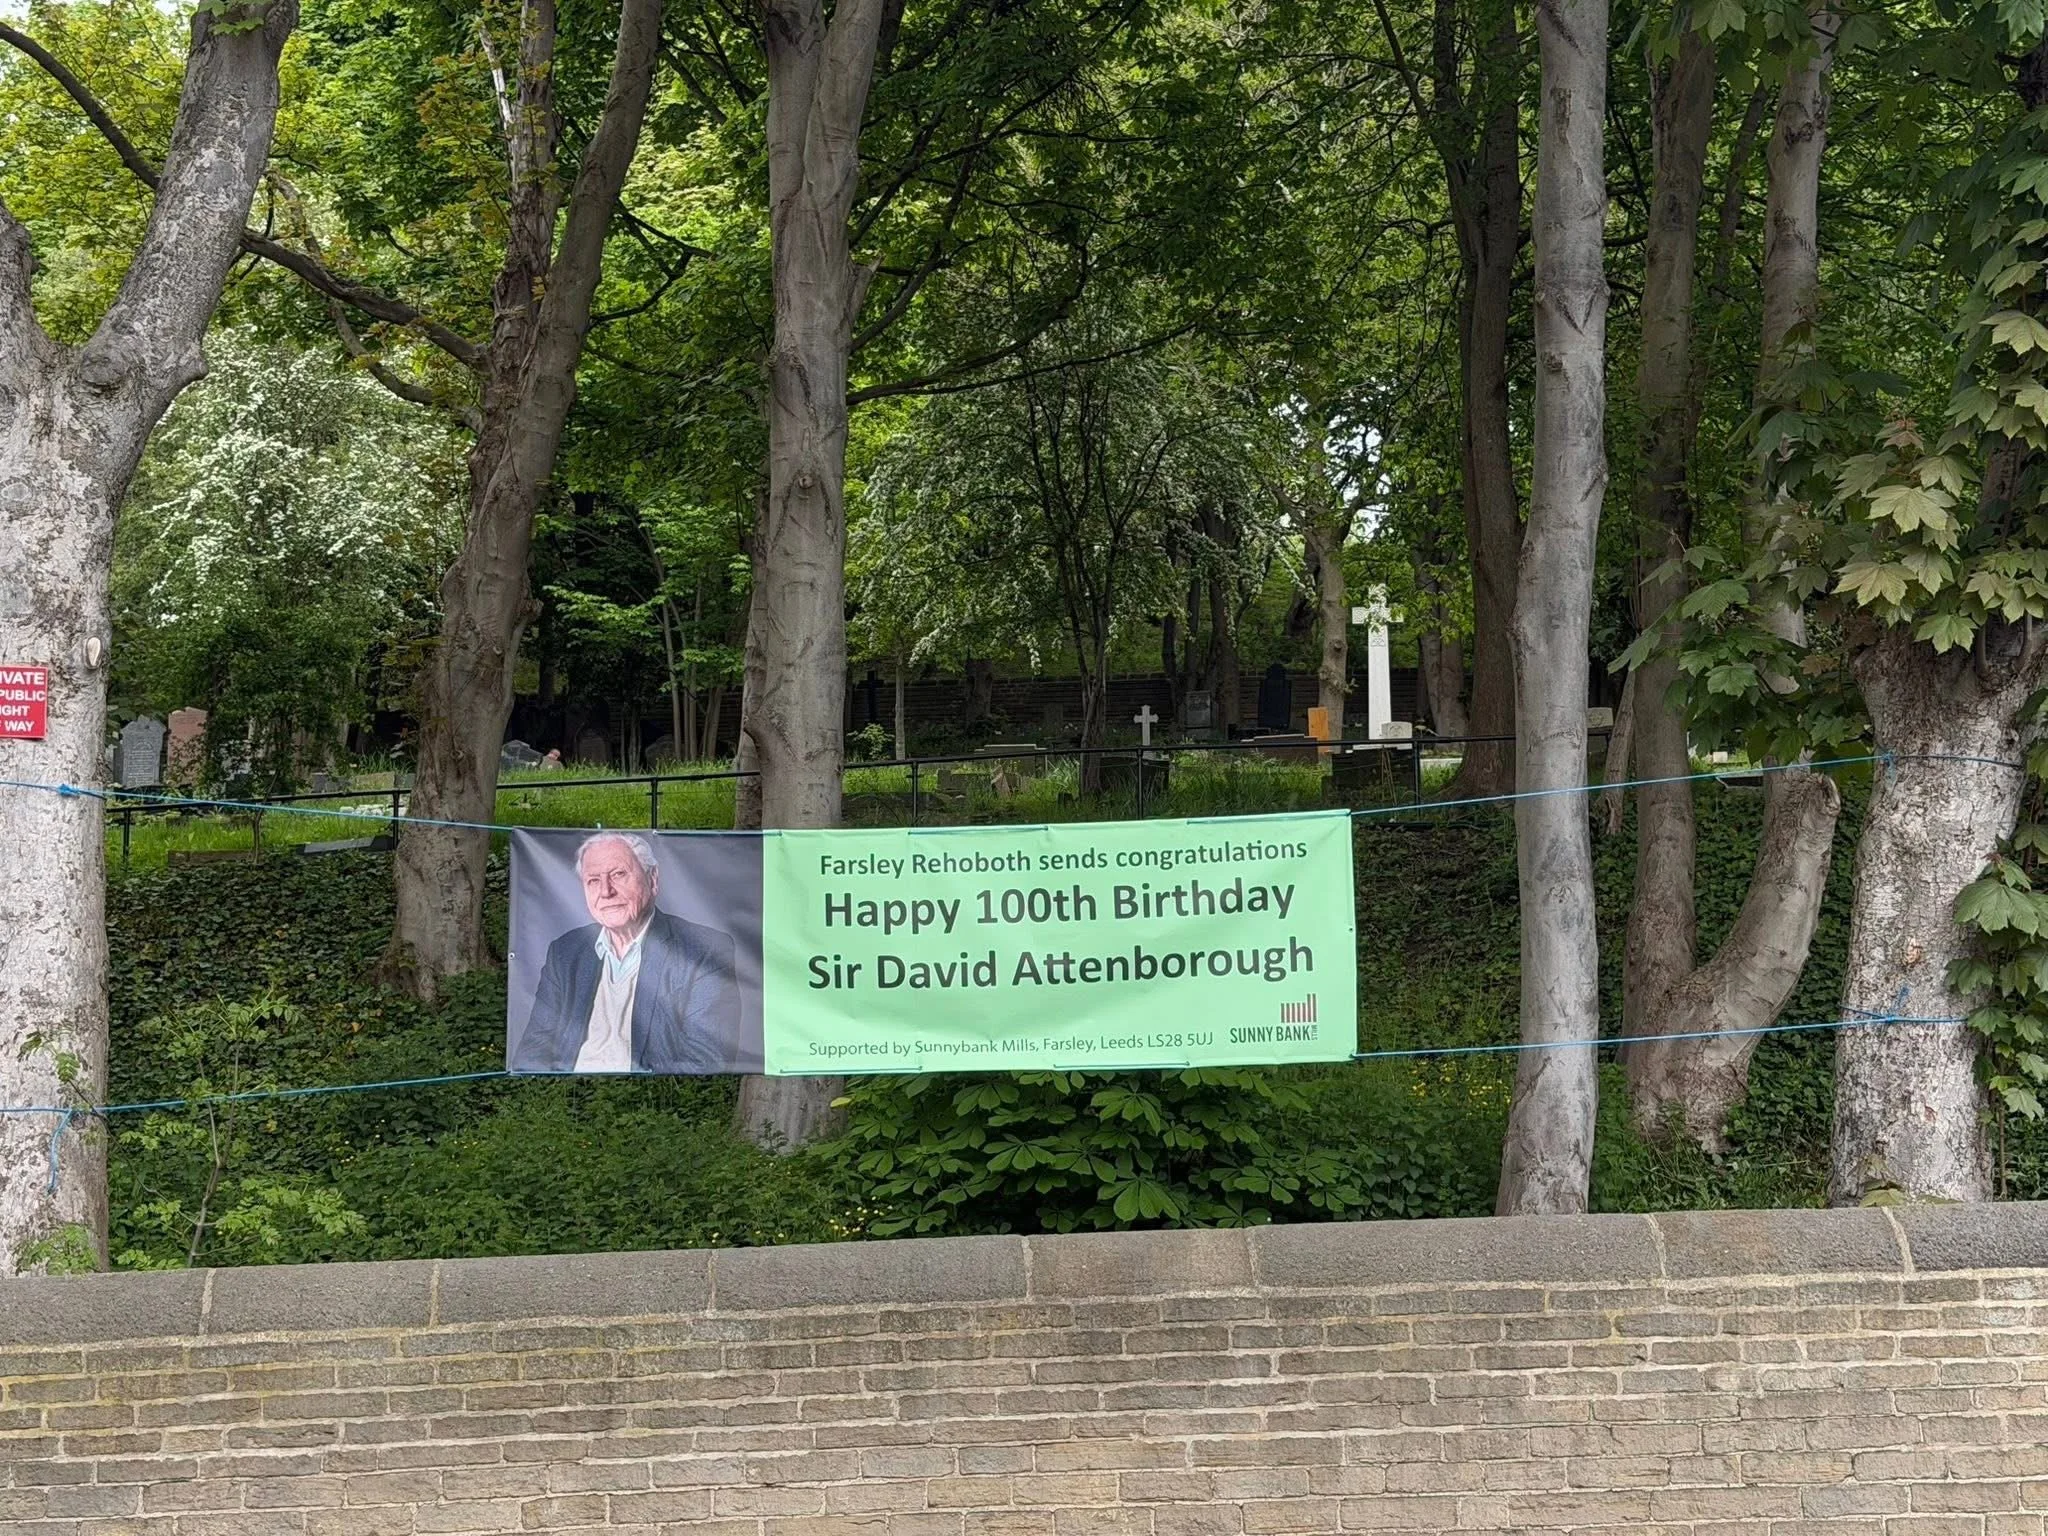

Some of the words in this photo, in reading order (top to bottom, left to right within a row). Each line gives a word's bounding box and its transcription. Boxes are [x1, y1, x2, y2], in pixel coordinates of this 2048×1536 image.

[4, 720, 35, 732] WAY
[820, 852, 905, 880] Farsley
[911, 849, 1031, 874] Rehoboth
[1038, 846, 1109, 871] sends
[1115, 839, 1308, 871] congratulations
[824, 892, 961, 935] Happy
[976, 884, 1097, 924] 100th
[1113, 876, 1296, 920] Birthday
[808, 953, 863, 990] Sir
[877, 949, 997, 990] David
[1011, 935, 1314, 987] Attenborough
[809, 1041, 888, 1058] Supported
[893, 1041, 911, 1057] by
[915, 1039, 999, 1056] Sunnybank
[1002, 1038, 1039, 1052] Mills,
[1043, 1036, 1097, 1053] Farsley,
[1100, 1034, 1144, 1050] Leeds
[1147, 1033, 1183, 1048] LS28
[1187, 1031, 1214, 1047] 5UJ
[1229, 1026, 1273, 1043] SUNNY
[1275, 1024, 1311, 1041] BANK
